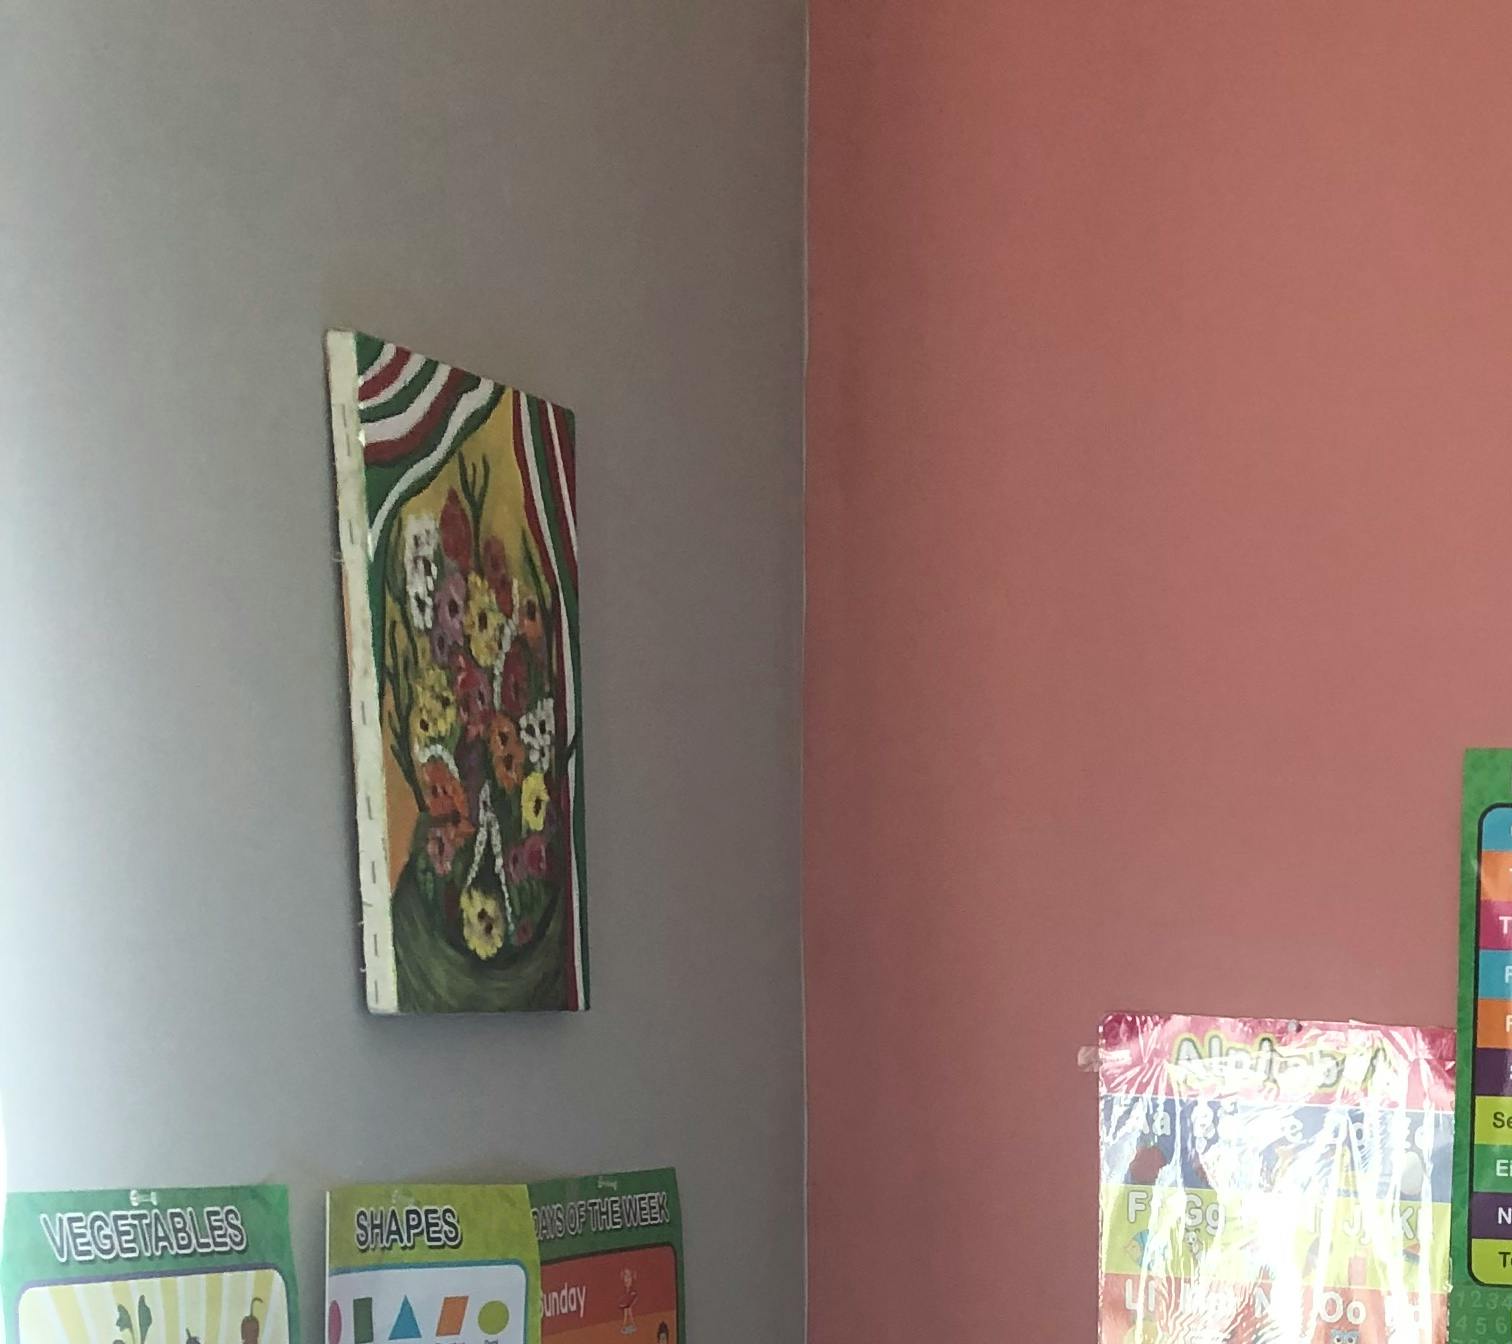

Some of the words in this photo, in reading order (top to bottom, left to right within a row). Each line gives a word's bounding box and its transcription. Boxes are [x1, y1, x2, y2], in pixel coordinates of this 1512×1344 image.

[40, 1205, 247, 1263] VEGETABLES
[354, 1205, 462, 1250] SHAPES
[567, 1202, 589, 1233] OF
[590, 1198, 622, 1229] THE
[621, 1192, 671, 1225] WEEK
